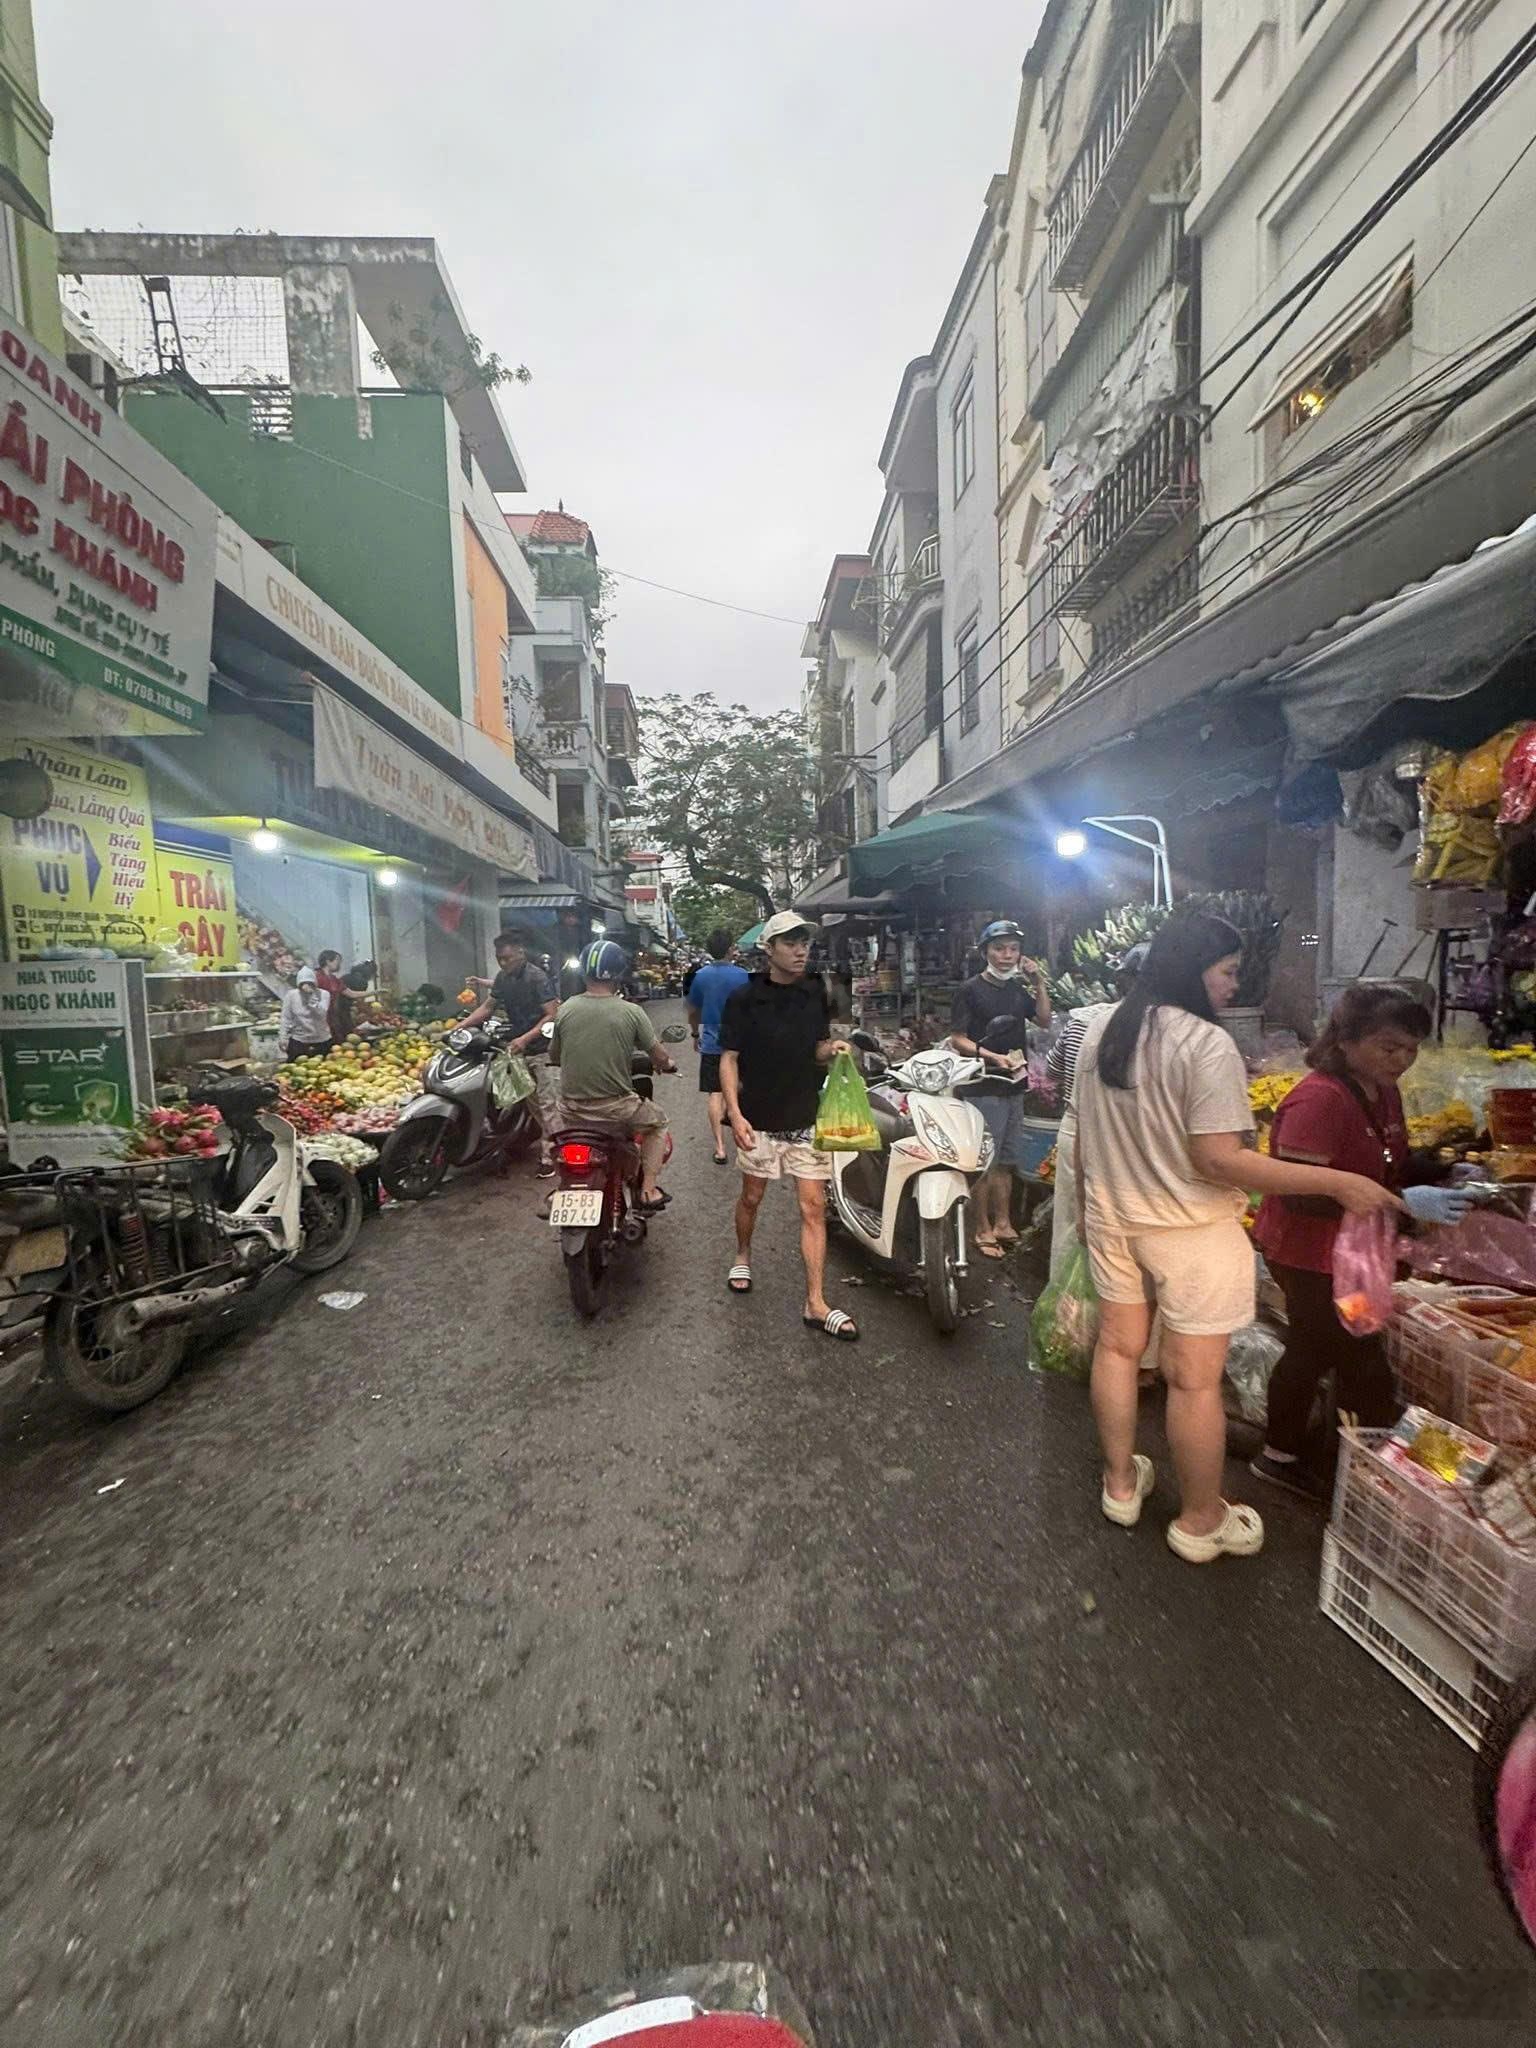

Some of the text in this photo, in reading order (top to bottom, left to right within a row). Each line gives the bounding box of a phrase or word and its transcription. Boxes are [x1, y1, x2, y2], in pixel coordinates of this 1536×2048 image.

[62, 456, 185, 584] PHÒNG
[52, 518, 158, 612] KHÁNH
[37, 861, 70, 903] VỤ
[48, 965, 97, 985] THUỐC
[2, 988, 116, 1014] NGỌC KHÁNH
